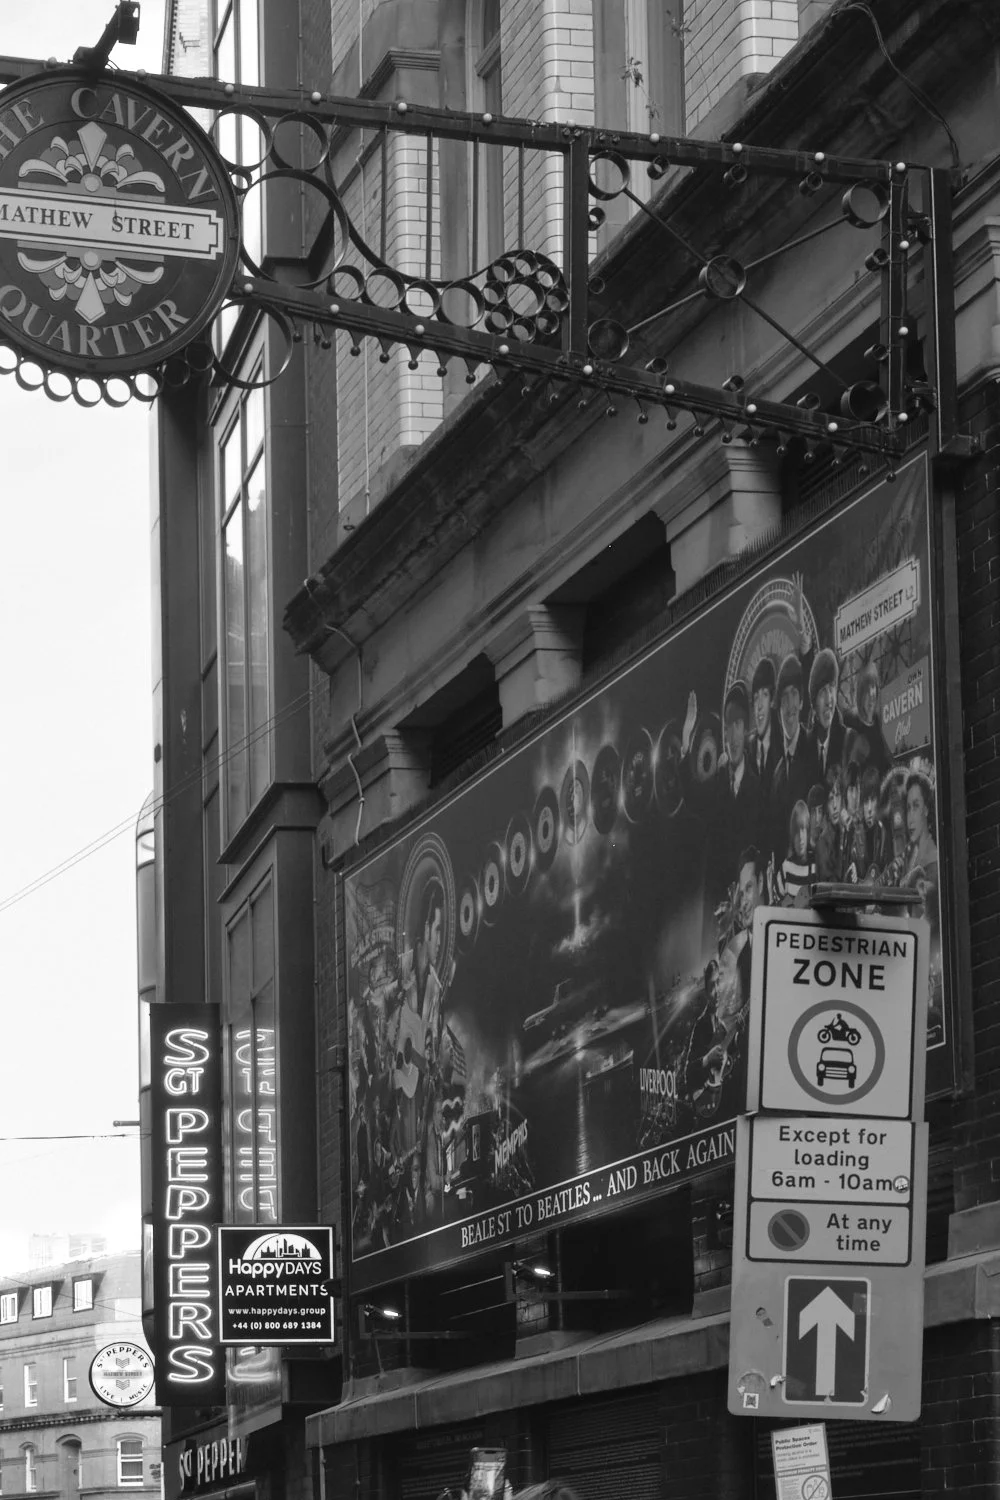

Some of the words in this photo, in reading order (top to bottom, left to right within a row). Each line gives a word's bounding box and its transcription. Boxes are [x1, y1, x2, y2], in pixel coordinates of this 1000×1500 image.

[70, 87, 219, 200] CAVERN
[111, 215, 194, 240] STREET
[840, 609, 872, 643] MATHEW
[873, 589, 904, 621] STREET
[882, 681, 923, 724] CAVERN
[776, 931, 908, 958] PEDESTRIAN
[792, 958, 887, 991] ZONE
[639, 1068, 679, 1100] LIVERPOOL
[494, 1118, 528, 1173] MEMPHIS
[778, 1125, 850, 1147] Except
[857, 1128, 887, 1146] for
[794, 1149, 870, 1171] loading
[461, 1214, 496, 1248] BEALE
[497, 1210, 512, 1235] ST
[515, 1203, 533, 1229] TO
[607, 1165, 637, 1197] AND
[643, 1149, 681, 1184] BACK
[686, 1128, 735, 1170] AGAIN
[771, 1170, 816, 1189] 6am
[838, 1173, 893, 1192] 10am
[826, 1213, 849, 1231] At
[855, 1217, 892, 1235] any
[165, 1108, 215, 1383] PEPPERS
[836, 1235, 881, 1252] time
[225, 1284, 328, 1296] APARTMENTS
[228, 1307, 326, 1316] www.happydays.group
[106, 1346, 149, 1368] PEPPERS
